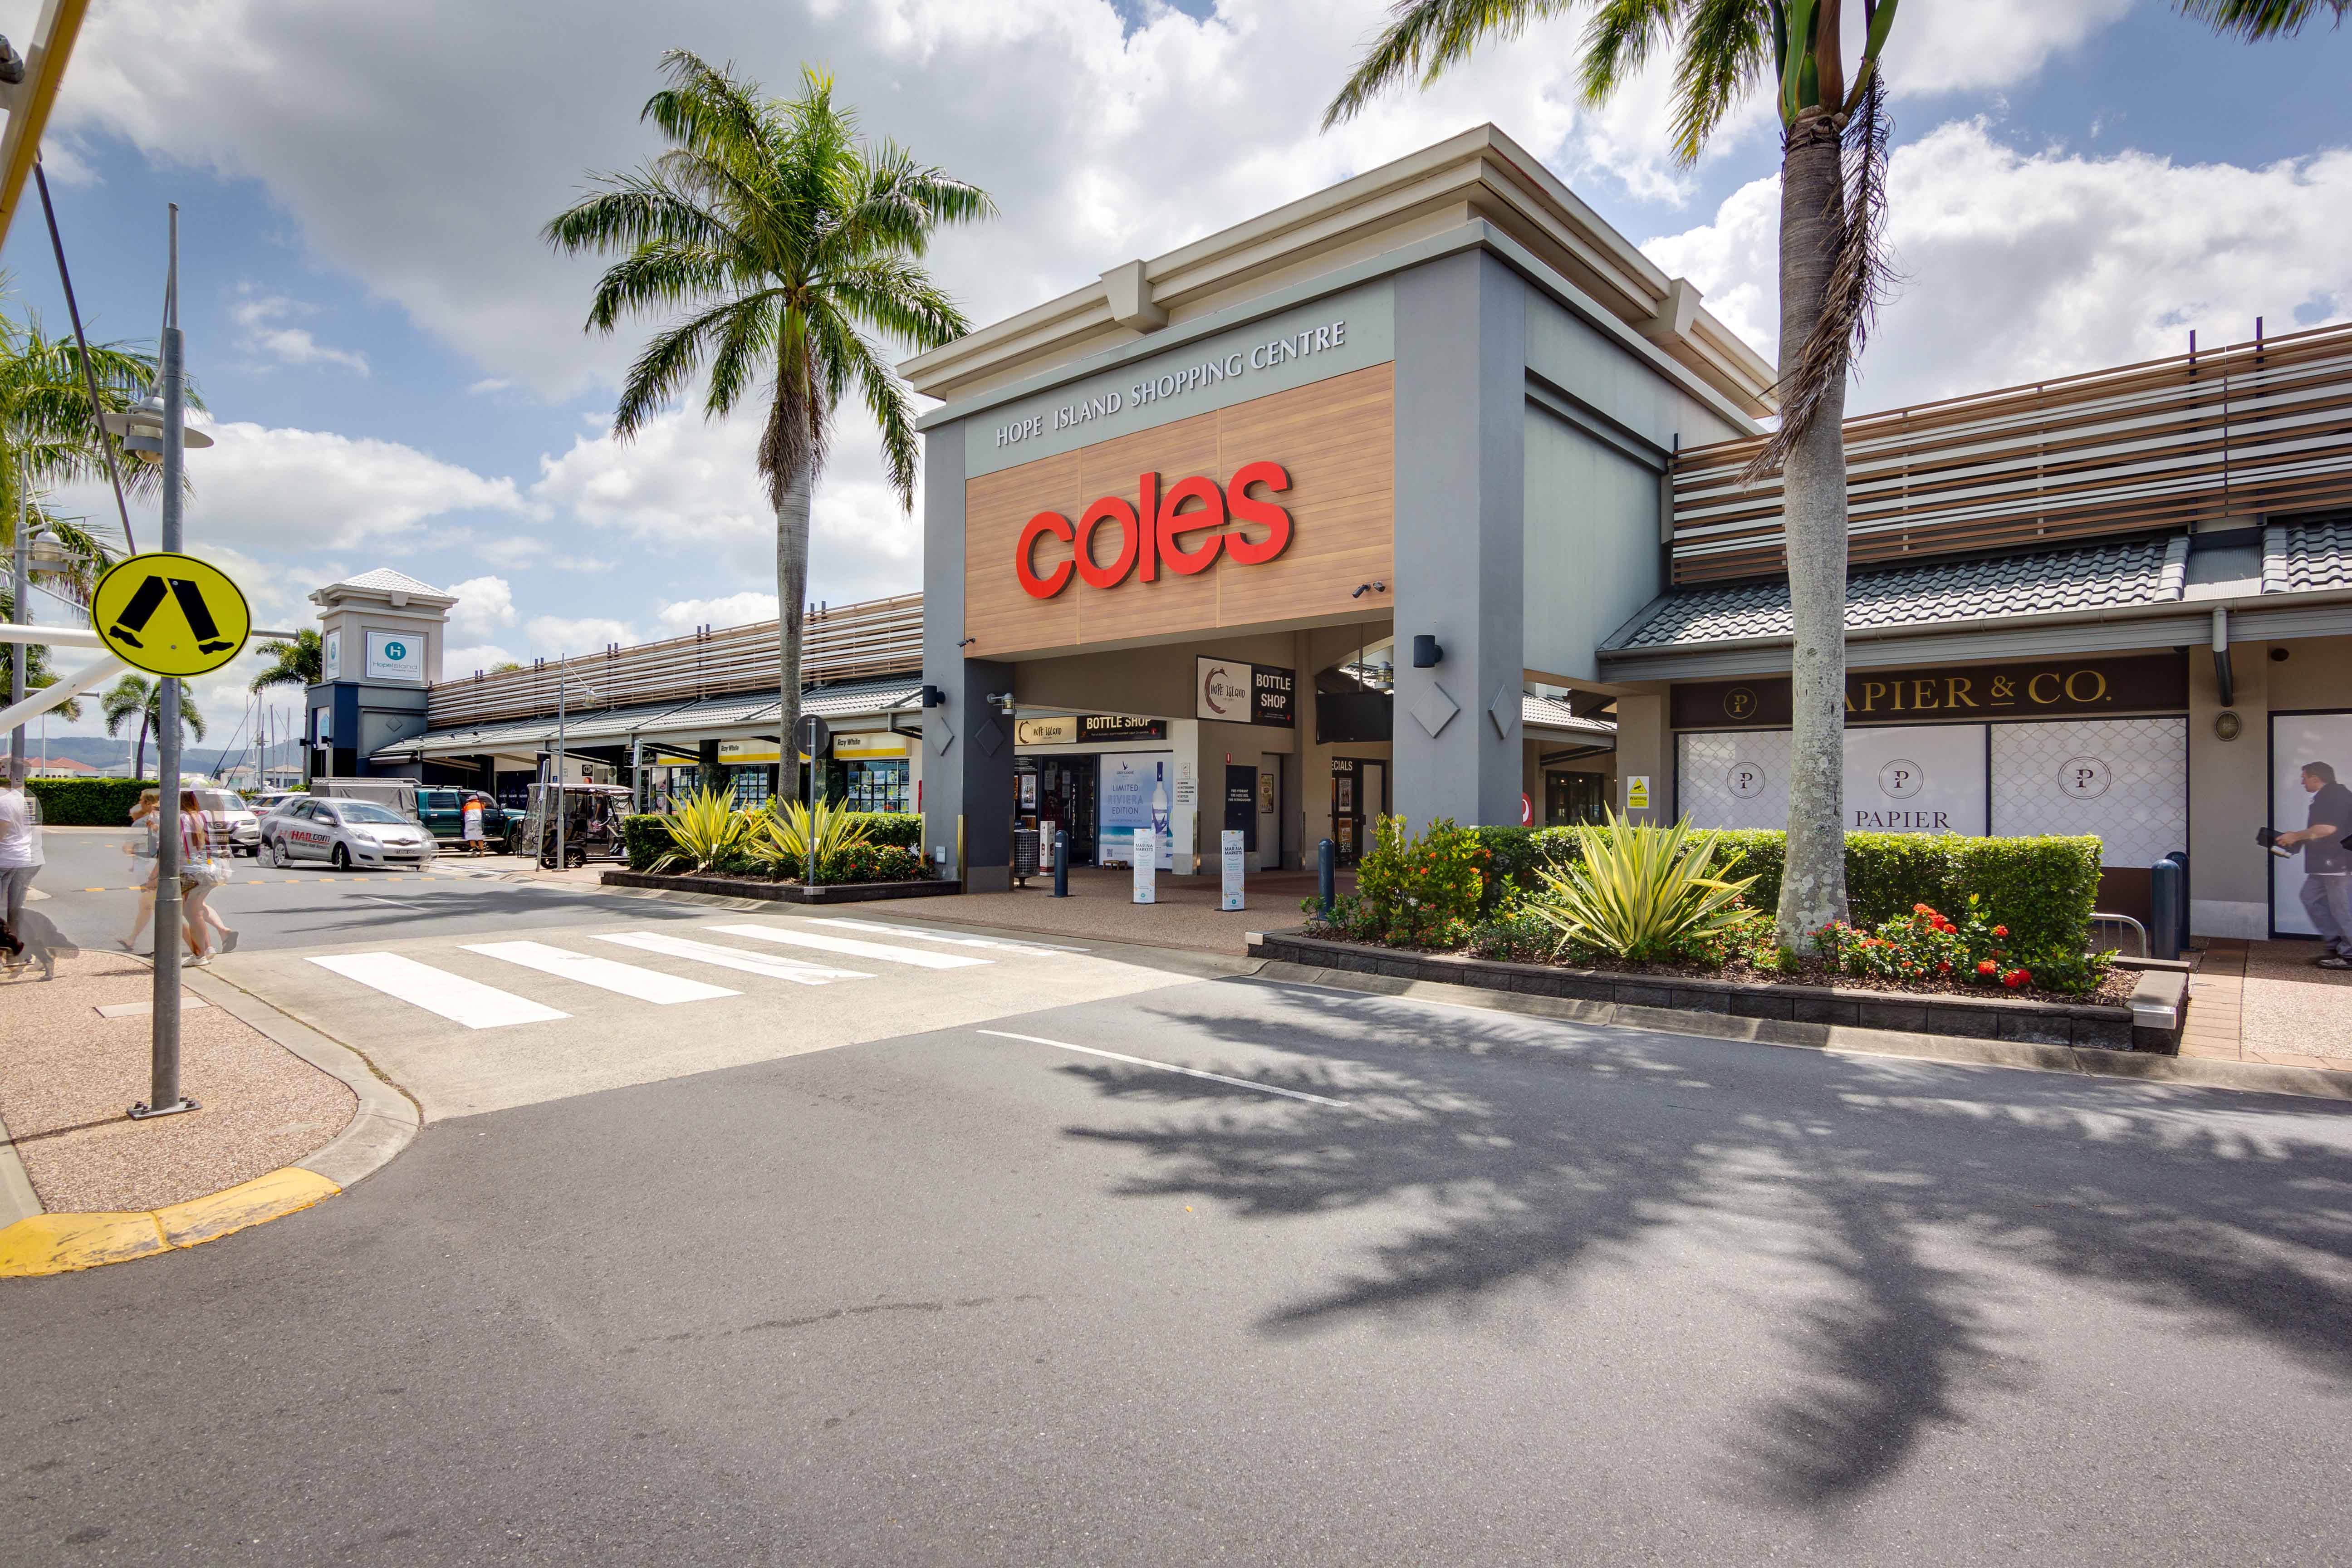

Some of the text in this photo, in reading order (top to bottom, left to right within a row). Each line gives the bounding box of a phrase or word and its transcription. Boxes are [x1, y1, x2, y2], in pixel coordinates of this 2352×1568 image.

[996, 320, 1345, 447] HOPE ISLAND SHOPPING CENTRE
[1016, 461, 1294, 599] coles
[1210, 682, 1225, 696] HOPE
[1256, 673, 1291, 691] BOTTLE
[1845, 678, 1980, 712] PIER
[2028, 670, 2112, 704] CO.
[1261, 693, 1286, 708] SHOP
[1087, 716, 1151, 730] BOTTLE SHOP
[837, 739, 847, 747] Ray
[1107, 794, 1144, 804] RIVIERA
[1855, 810, 1952, 828] PAPIER
